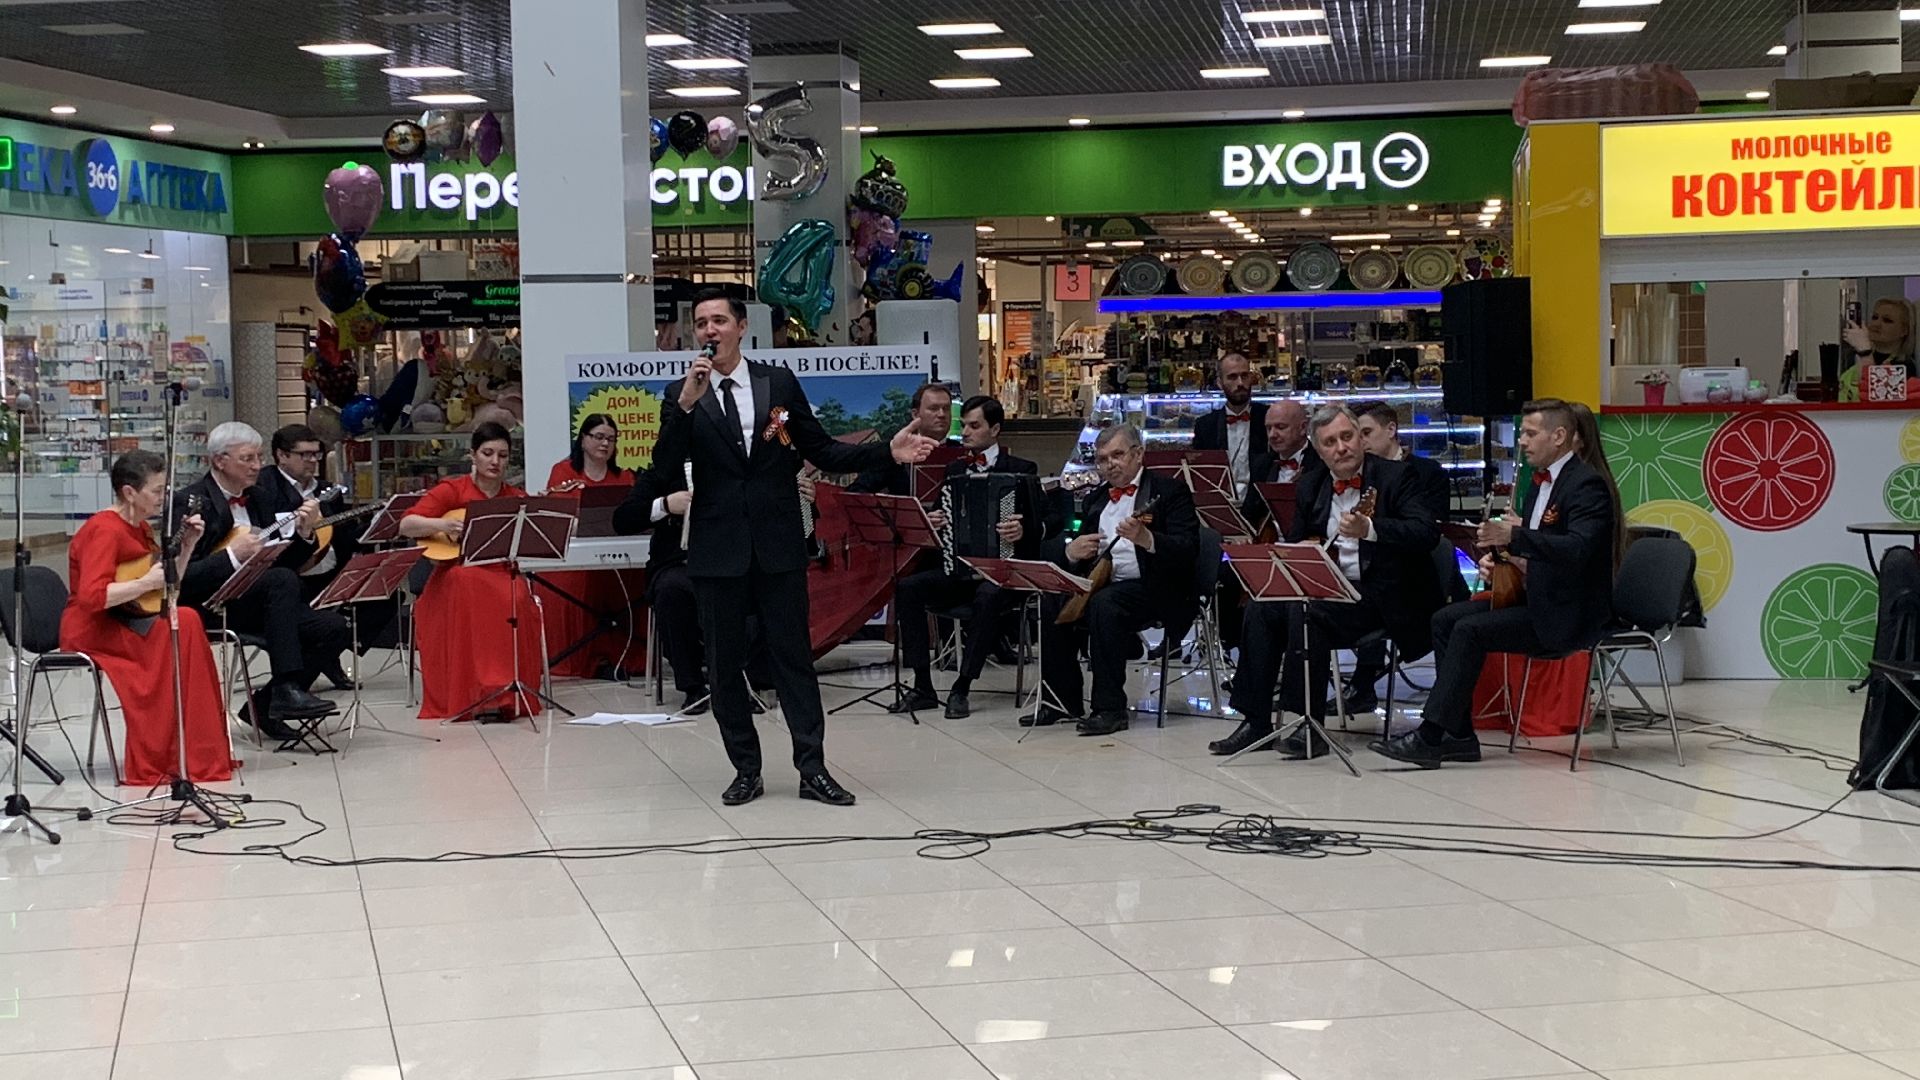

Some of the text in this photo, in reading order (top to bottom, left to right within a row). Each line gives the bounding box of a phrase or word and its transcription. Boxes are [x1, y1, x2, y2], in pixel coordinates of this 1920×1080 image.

[1223, 141, 1366, 190] ВХОД
[123, 159, 228, 213] АПТЕКА
[1671, 160, 1920, 218] коктейл
[1067, 271, 1080, 292] 3
[578, 361, 692, 378] КОМФОРТН
[798, 358, 809, 371] В
[816, 352, 919, 372] ПОСЁЛКЕ!
[607, 396, 639, 410] ДОМ
[618, 412, 655, 425] ЦЕНЕ
